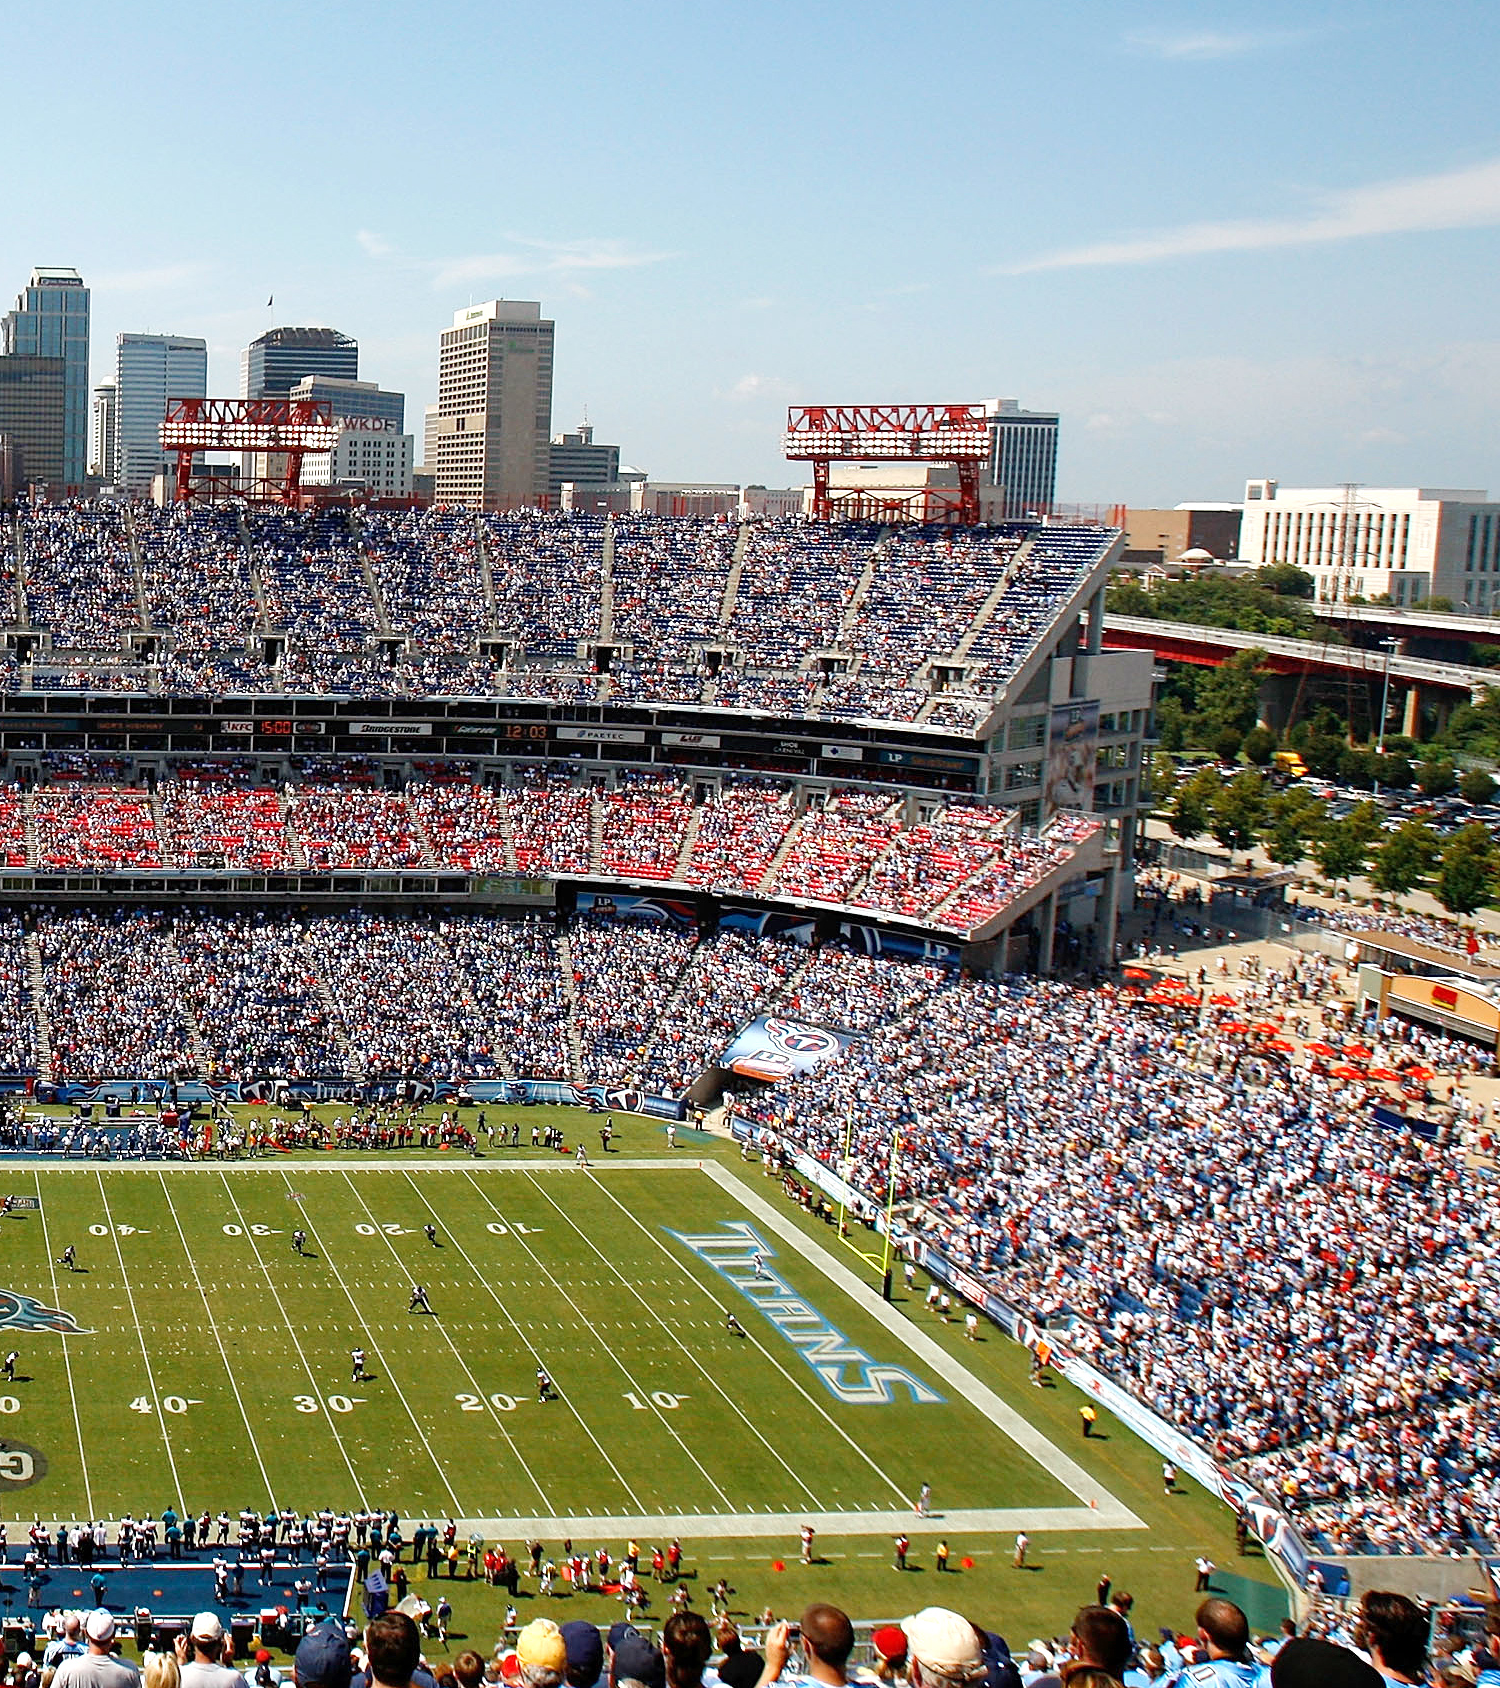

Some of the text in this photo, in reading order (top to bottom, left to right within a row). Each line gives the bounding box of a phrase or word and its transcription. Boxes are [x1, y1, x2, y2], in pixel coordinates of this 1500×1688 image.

[231, 722, 253, 732] KFC
[361, 724, 421, 734] BRIDGESTONE
[587, 732, 624, 740] PAETEC
[888, 753, 903, 762] LP
[598, 897, 611, 906] LP
[924, 942, 949, 959] LP
[88, 1223, 137, 1236] 40
[222, 1223, 269, 1236] 30
[354, 1223, 401, 1236] 20
[486, 1222, 533, 1235] 10
[659, 1220, 948, 1405] TITANS
[129, 1395, 188, 1415] 40
[293, 1394, 355, 1414] 30
[454, 1392, 518, 1412] 20
[621, 1390, 681, 1410] 10
